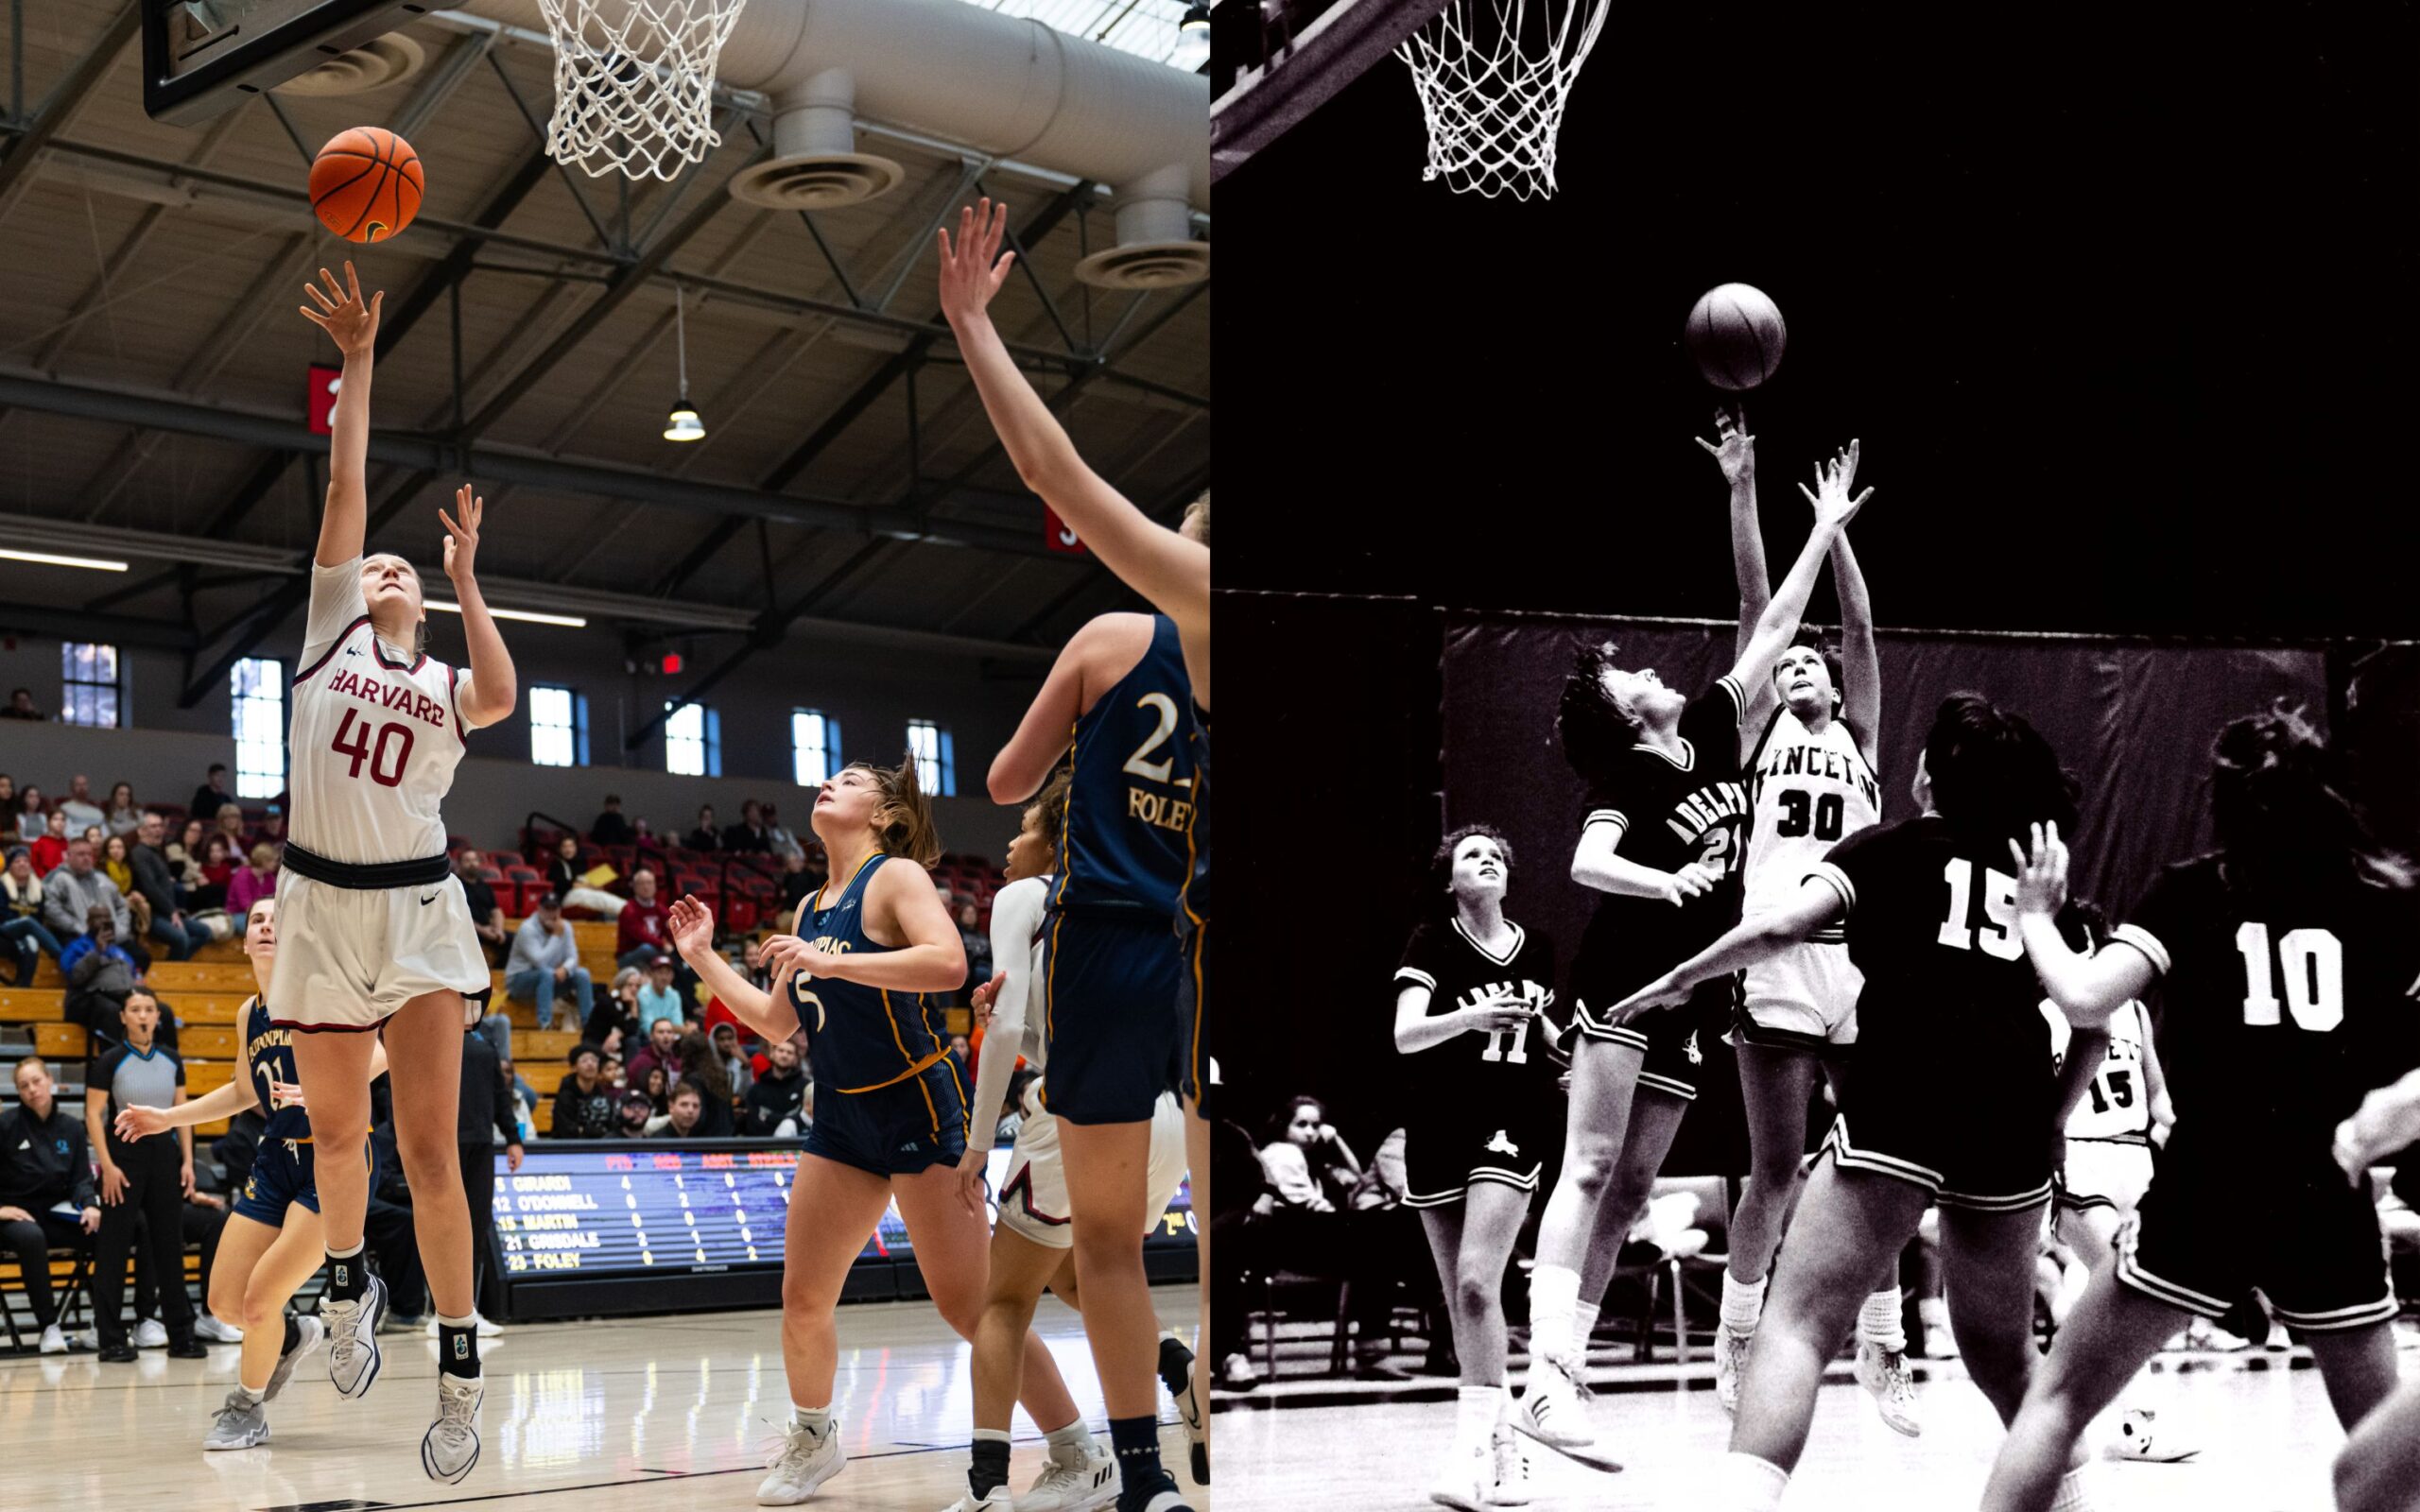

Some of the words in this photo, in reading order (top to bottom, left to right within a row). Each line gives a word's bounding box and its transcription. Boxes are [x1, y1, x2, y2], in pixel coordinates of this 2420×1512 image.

[328, 668, 445, 728] HARVARD
[332, 707, 414, 787] 40
[1123, 693, 1192, 784] 2
[1777, 788, 1844, 842] 30
[1698, 822, 1741, 870] 21
[1937, 856, 2025, 962] 15
[2235, 920, 2344, 1032] 10
[795, 971, 826, 1033] 5
[1481, 1018, 1528, 1064] 11
[2089, 1071, 2134, 1114] 15
[493, 1196, 511, 1212] 12
[626, 1194, 636, 1210] 0
[679, 1193, 690, 1208] 2
[731, 1191, 741, 1206] 1
[621, 1175, 631, 1191] 4
[674, 1174, 683, 1189] 1
[724, 1172, 735, 1188] 0
[774, 1171, 786, 1187] 0
[498, 1215, 516, 1231] 15
[523, 1214, 579, 1230] MARTIN
[631, 1212, 642, 1228] 0
[684, 1211, 695, 1227] 0
[735, 1209, 746, 1225] 0
[505, 1235, 523, 1251] 21
[637, 1231, 648, 1247] 2
[691, 1229, 700, 1245] 1
[741, 1227, 752, 1243] 0
[508, 1254, 527, 1270] 23
[533, 1253, 580, 1269] FOLEY
[642, 1250, 653, 1266] 0
[696, 1248, 706, 1263] 4
[747, 1246, 758, 1261] 2
